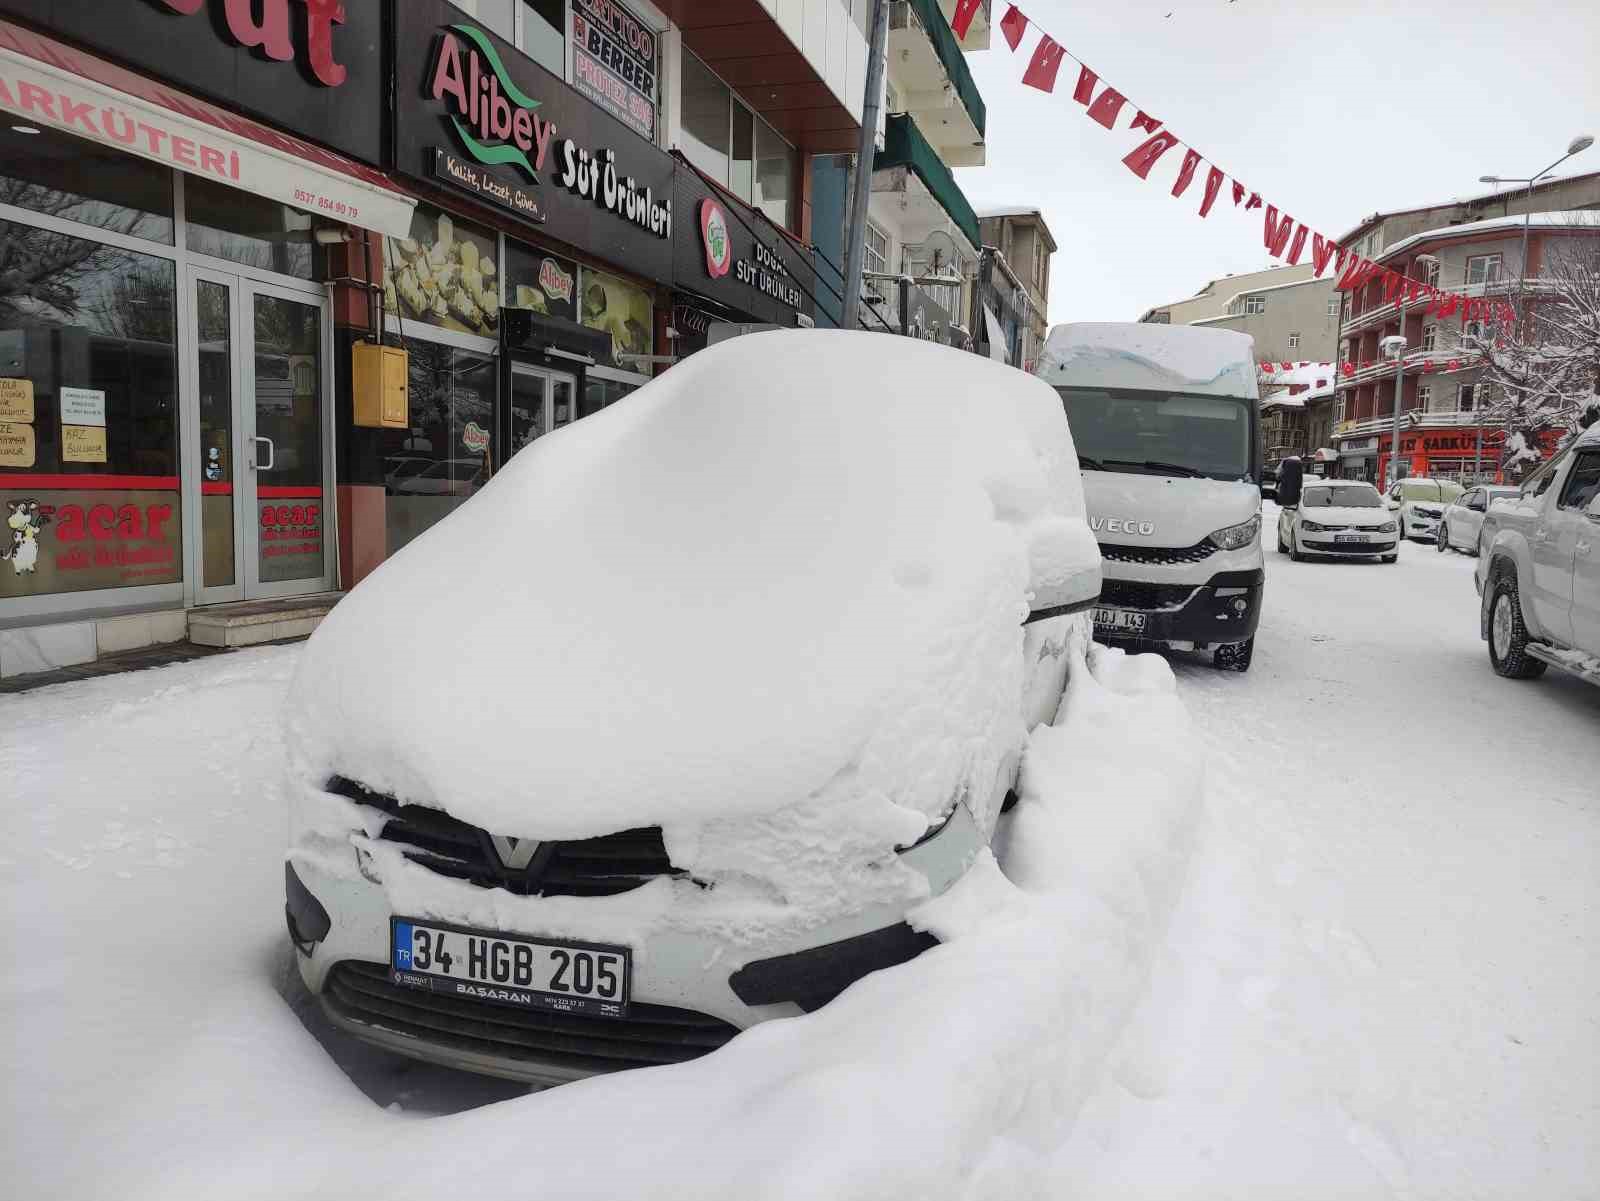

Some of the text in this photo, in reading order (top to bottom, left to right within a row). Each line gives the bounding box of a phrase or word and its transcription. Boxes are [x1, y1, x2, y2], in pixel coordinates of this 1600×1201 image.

[588, 27, 654, 98] BERBER
[433, 33, 550, 170] Alibey
[562, 139, 599, 200] Süt
[604, 149, 672, 240] Ürünleri
[737, 259, 756, 286] SÜT
[57, 504, 172, 542] acar
[262, 505, 320, 527] acar
[1094, 610, 1145, 627] ADJ 143
[397, 948, 410, 962] TR
[414, 930, 618, 998] 34 HGB 205
